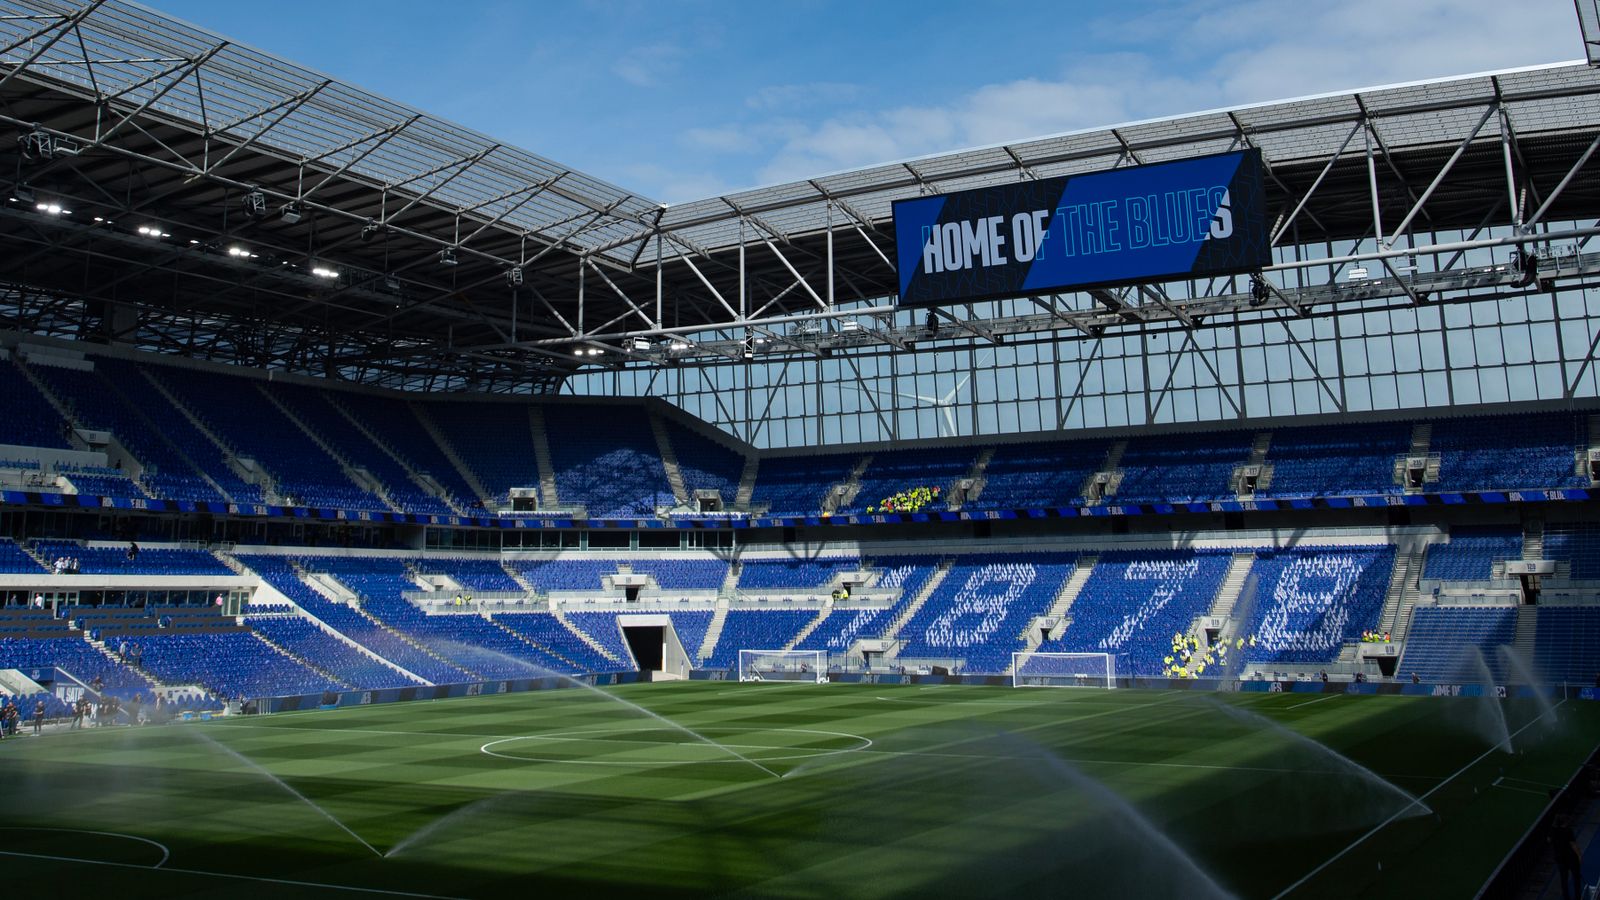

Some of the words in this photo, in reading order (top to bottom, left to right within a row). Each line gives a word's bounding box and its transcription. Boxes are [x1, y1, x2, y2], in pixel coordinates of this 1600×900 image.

[921, 214, 1007, 274] HOME
[1012, 209, 1049, 262] OF
[1056, 199, 1121, 257] THE
[1126, 185, 1234, 250] BLUES
